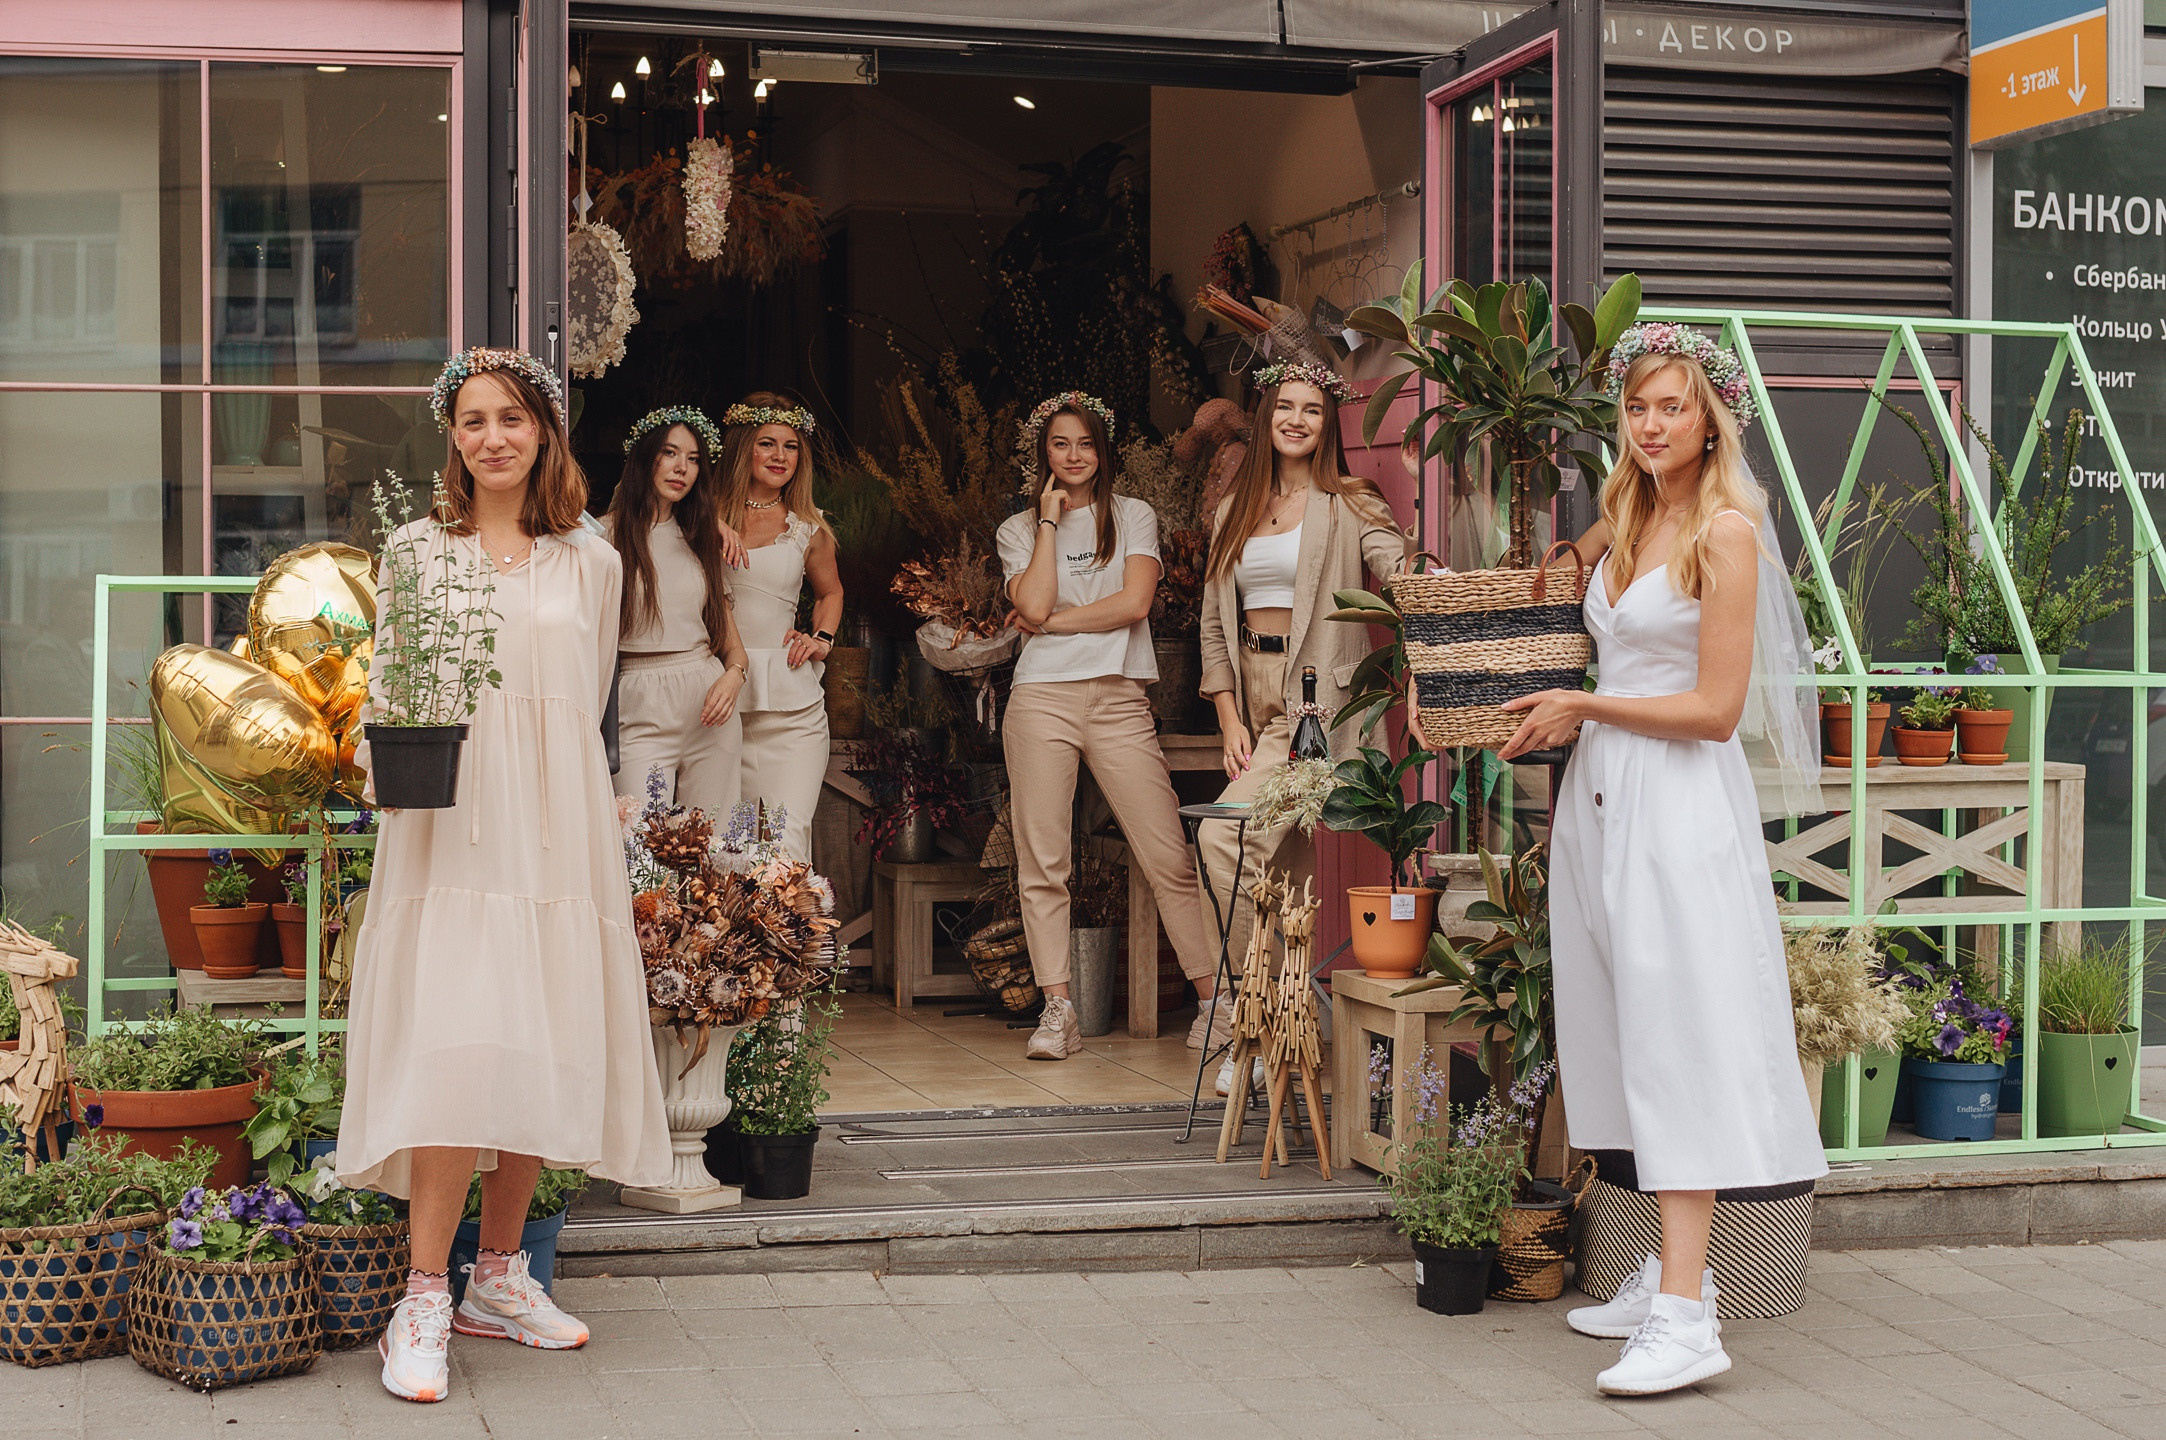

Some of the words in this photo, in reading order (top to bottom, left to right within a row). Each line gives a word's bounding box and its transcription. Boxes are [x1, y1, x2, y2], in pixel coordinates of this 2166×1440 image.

[1659, 22, 1793, 54] ДЕКОР
[2001, 72, 2017, 99] -1
[2021, 66, 2060, 95] этаж
[2072, 314, 2153, 343] Кольцо
[2071, 364, 2137, 389] Знит
[1956, 1105, 1983, 1113] Endless
